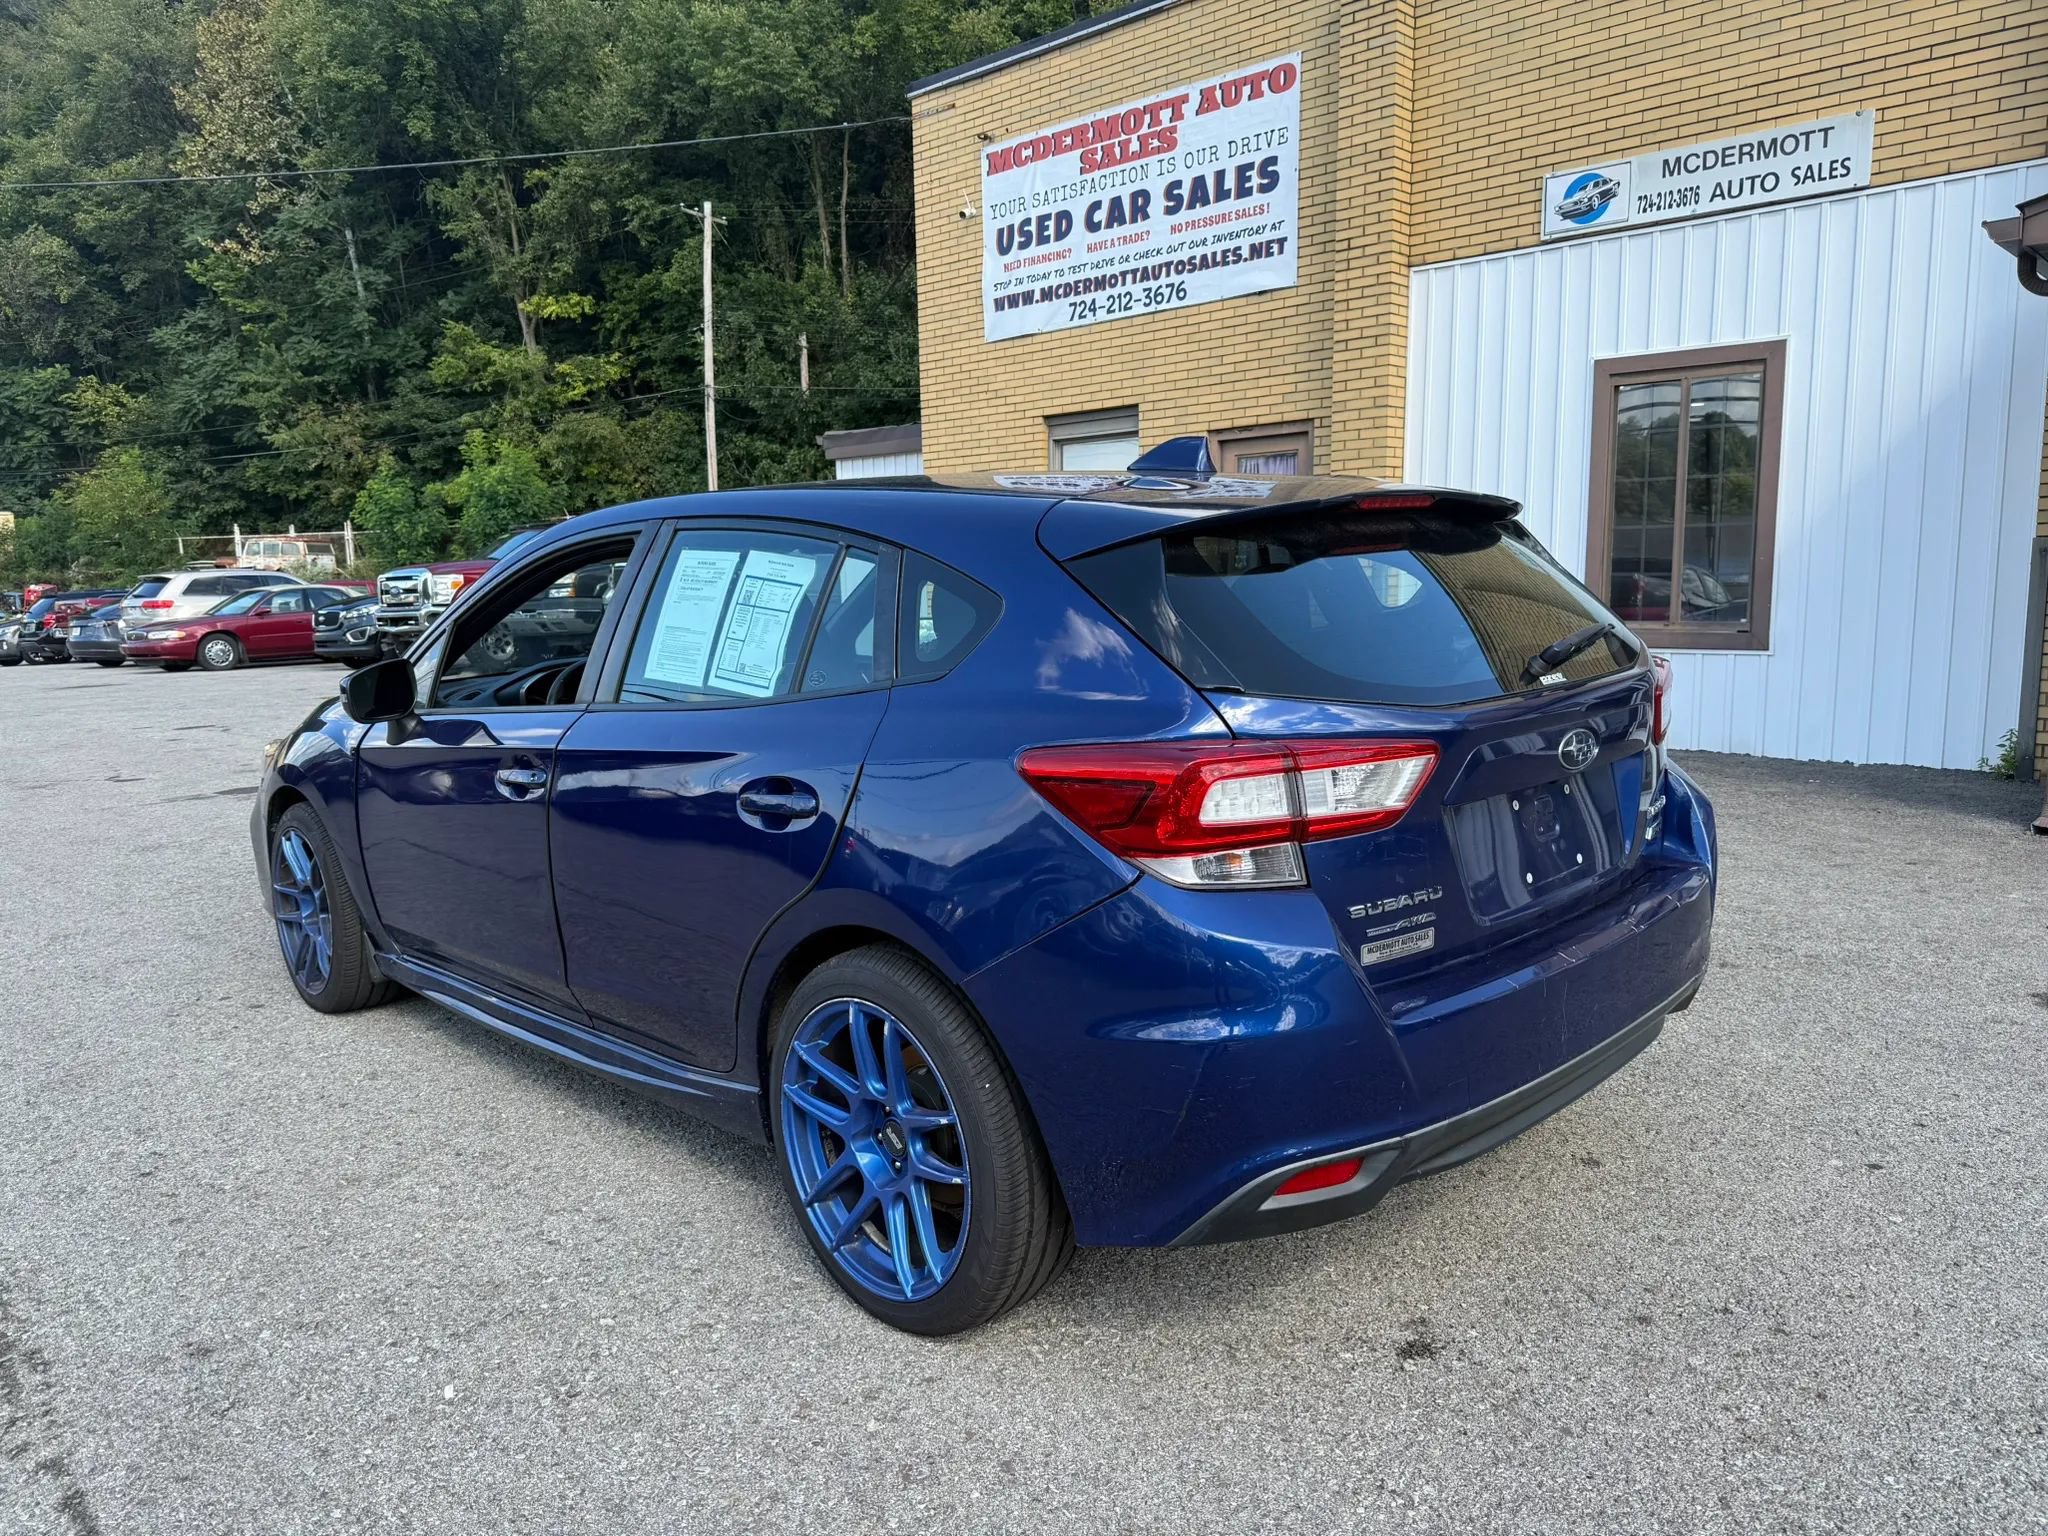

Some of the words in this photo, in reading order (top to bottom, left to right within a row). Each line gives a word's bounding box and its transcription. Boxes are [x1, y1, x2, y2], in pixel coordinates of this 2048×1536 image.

[986, 93, 1190, 177] MCDERMOTT
[1195, 62, 1297, 116] AUTO
[1080, 124, 1178, 176] SALES
[1662, 126, 1835, 178] MCDERMOTT
[990, 196, 1027, 221] YOUR
[1032, 163, 1149, 209] SATISFACTION
[1157, 156, 1176, 177] IS
[1184, 145, 1219, 169] OUR
[1228, 126, 1289, 159] DRIVE
[1709, 171, 1780, 203] AUTO
[1791, 157, 1851, 186] SALES
[996, 209, 1073, 257] USED
[1084, 188, 1151, 234] CAR
[1163, 155, 1280, 216] SALES
[1170, 223, 1183, 235] NO
[1184, 211, 1233, 232] PRESSURE
[1637, 185, 1700, 215] 724-212-3676
[993, 280, 1012, 292] STOP
[1014, 277, 1024, 287] IN
[1026, 271, 1053, 285] TODAY
[1054, 268, 1065, 278] TO
[1067, 263, 1088, 276] TEST
[1090, 257, 1115, 271] DRIVE
[1118, 254, 1131, 265] OR
[1134, 247, 1163, 261] CHECK
[1166, 242, 1187, 254] OUT
[1188, 237, 1208, 250] OUR
[1211, 224, 1268, 245] INVENTORY
[1269, 220, 1285, 232] AT
[1003, 259, 1022, 273] NEED
[1023, 247, 1072, 268] FINANCING?
[1087, 239, 1109, 254] HAVE
[1109, 238, 1117, 249] A
[1116, 230, 1150, 248] TRADE?
[993, 236, 1288, 312] WWW.MCDERMOTTAUTOSALES.NET
[1069, 280, 1187, 322] 724-212-3676
[1348, 885, 1443, 919] SUBARU
[1367, 940, 1400, 954] MCDERMOTT
[1401, 936, 1414, 946] AUTO
[1415, 931, 1430, 943] SALES
